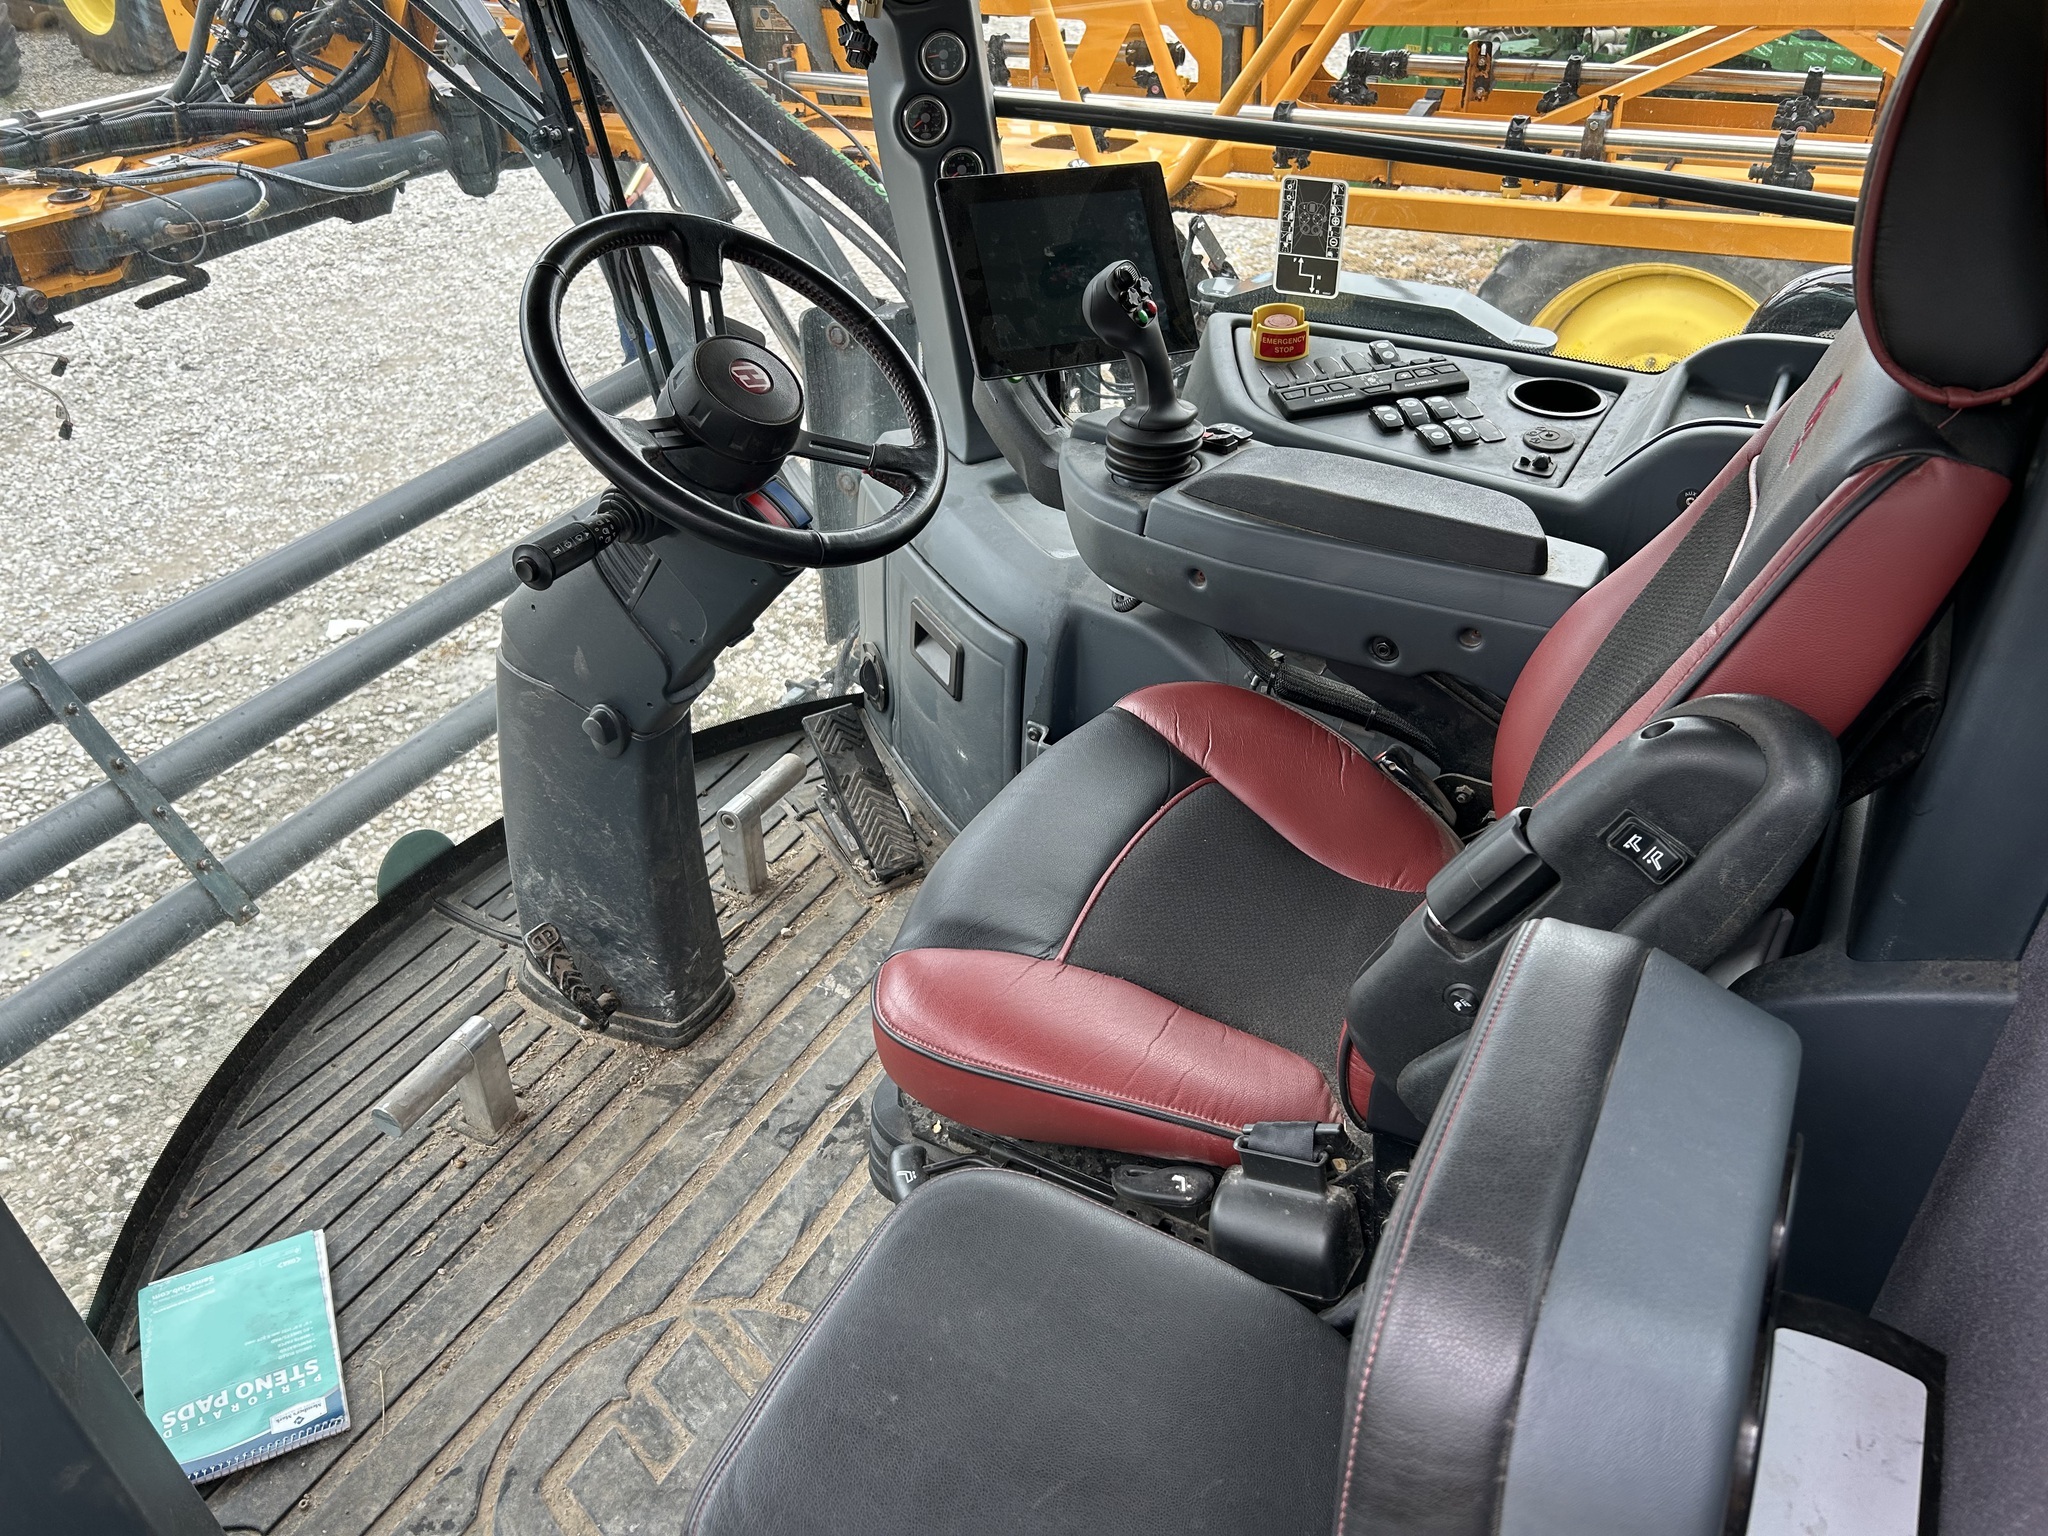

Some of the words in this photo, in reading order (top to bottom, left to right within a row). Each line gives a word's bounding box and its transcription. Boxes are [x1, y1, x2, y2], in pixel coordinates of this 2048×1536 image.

[1262, 334, 1306, 345] EMERGENCY
[1274, 346, 1294, 354] STOP
[151, 1275, 215, 1300] SamsClub.com
[235, 1359, 320, 1400] STENO
[161, 1389, 229, 1429] PADS
[162, 1373, 323, 1439] PERFORATED
[275, 1414, 292, 1423] Mark
